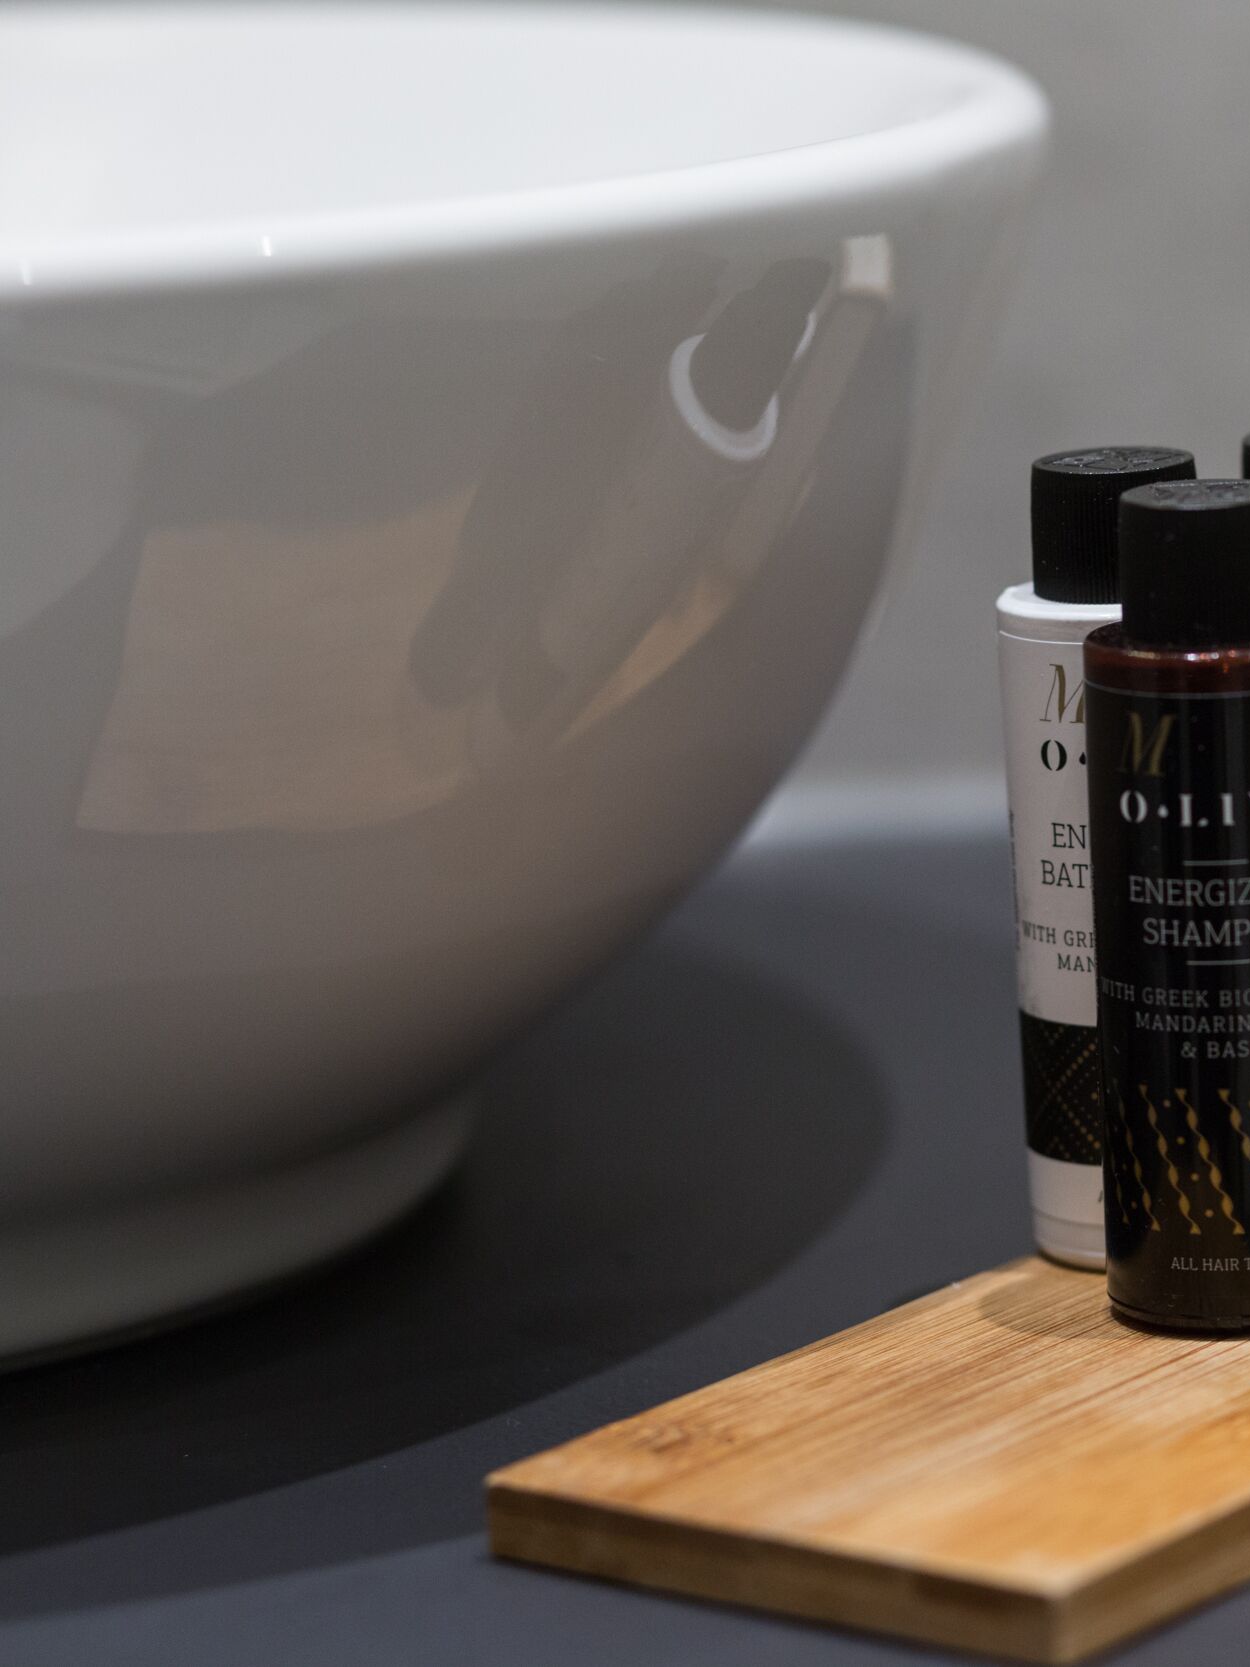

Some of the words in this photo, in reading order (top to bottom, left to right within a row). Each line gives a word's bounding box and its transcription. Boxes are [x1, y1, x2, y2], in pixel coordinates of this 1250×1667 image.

[1040, 664, 1084, 723] M
[1117, 710, 1176, 777] M
[1041, 859, 1093, 889] BAT
[1022, 920, 1056, 945] WITH
[1101, 977, 1135, 1002] WITH
[1141, 986, 1210, 1009] GREEK
[1180, 1041, 1197, 1059] &
[1171, 1256, 1199, 1271] ALL
[1202, 1257, 1240, 1272] HAIR
